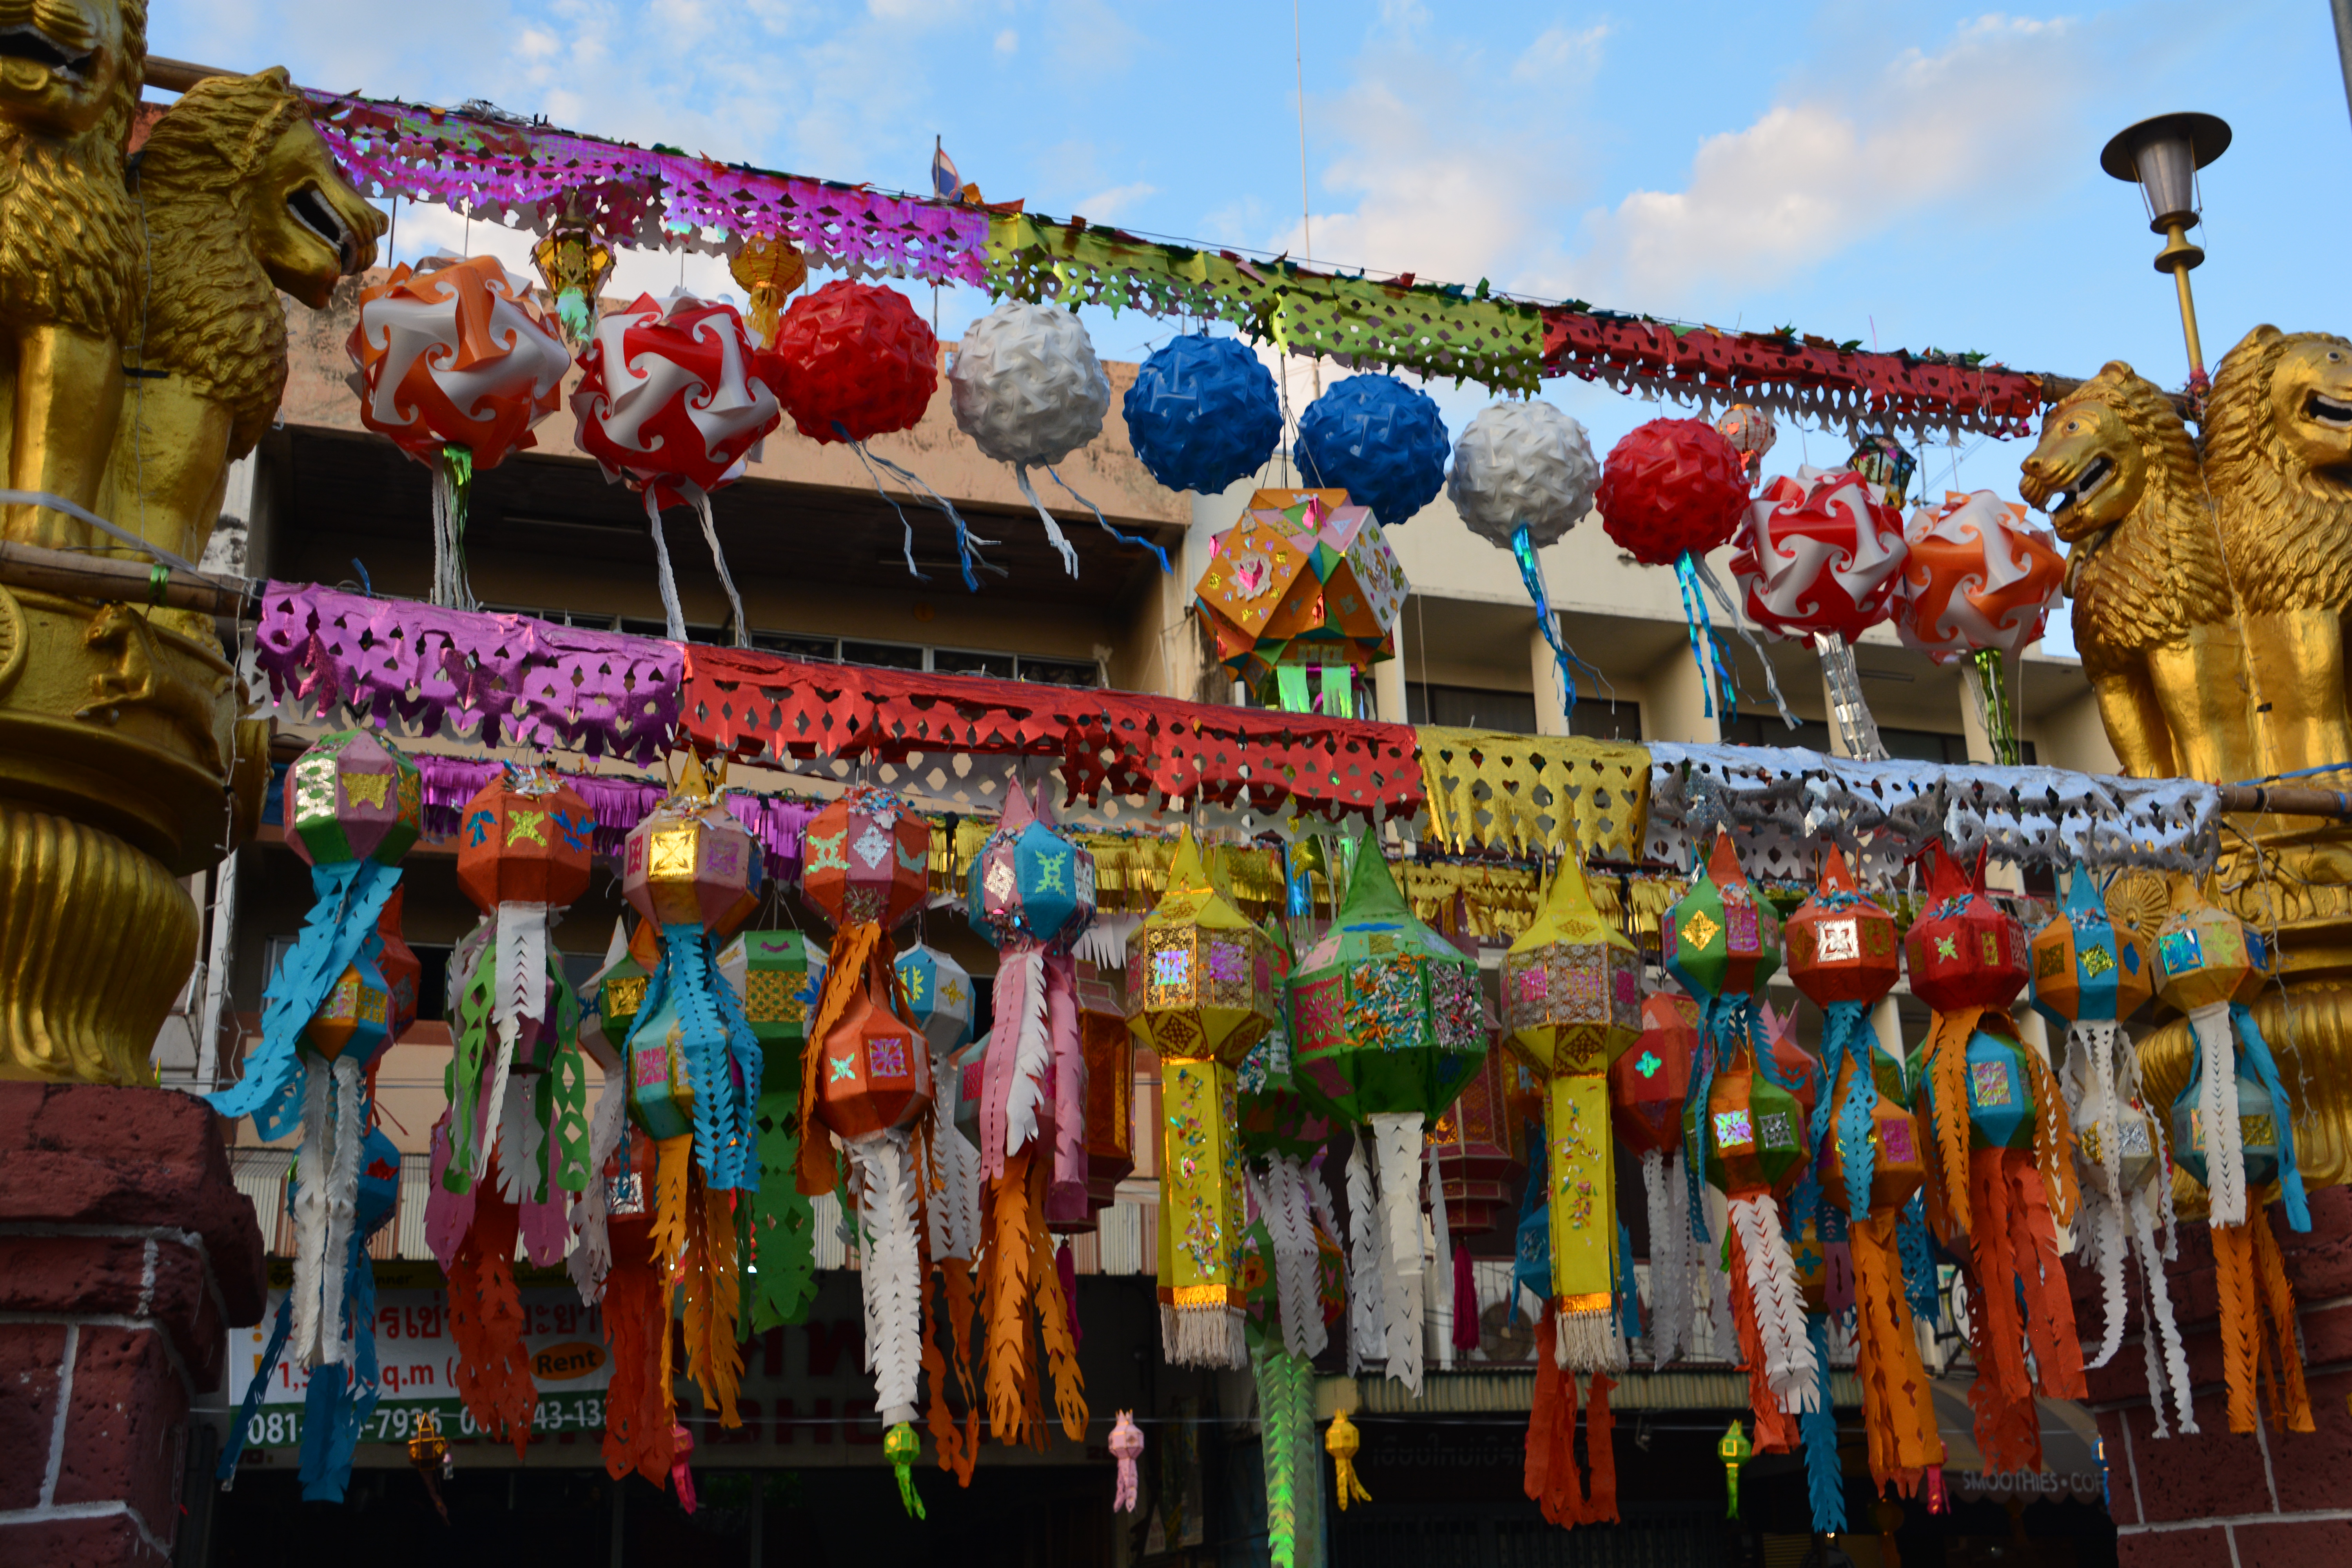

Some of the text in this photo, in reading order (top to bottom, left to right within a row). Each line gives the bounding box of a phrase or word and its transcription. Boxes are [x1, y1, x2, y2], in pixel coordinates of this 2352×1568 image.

[537, 1350, 597, 1374] Rent
[367, 1363, 433, 1392] q.m
[1962, 1469, 2104, 1493] SMOOTHIES COF
